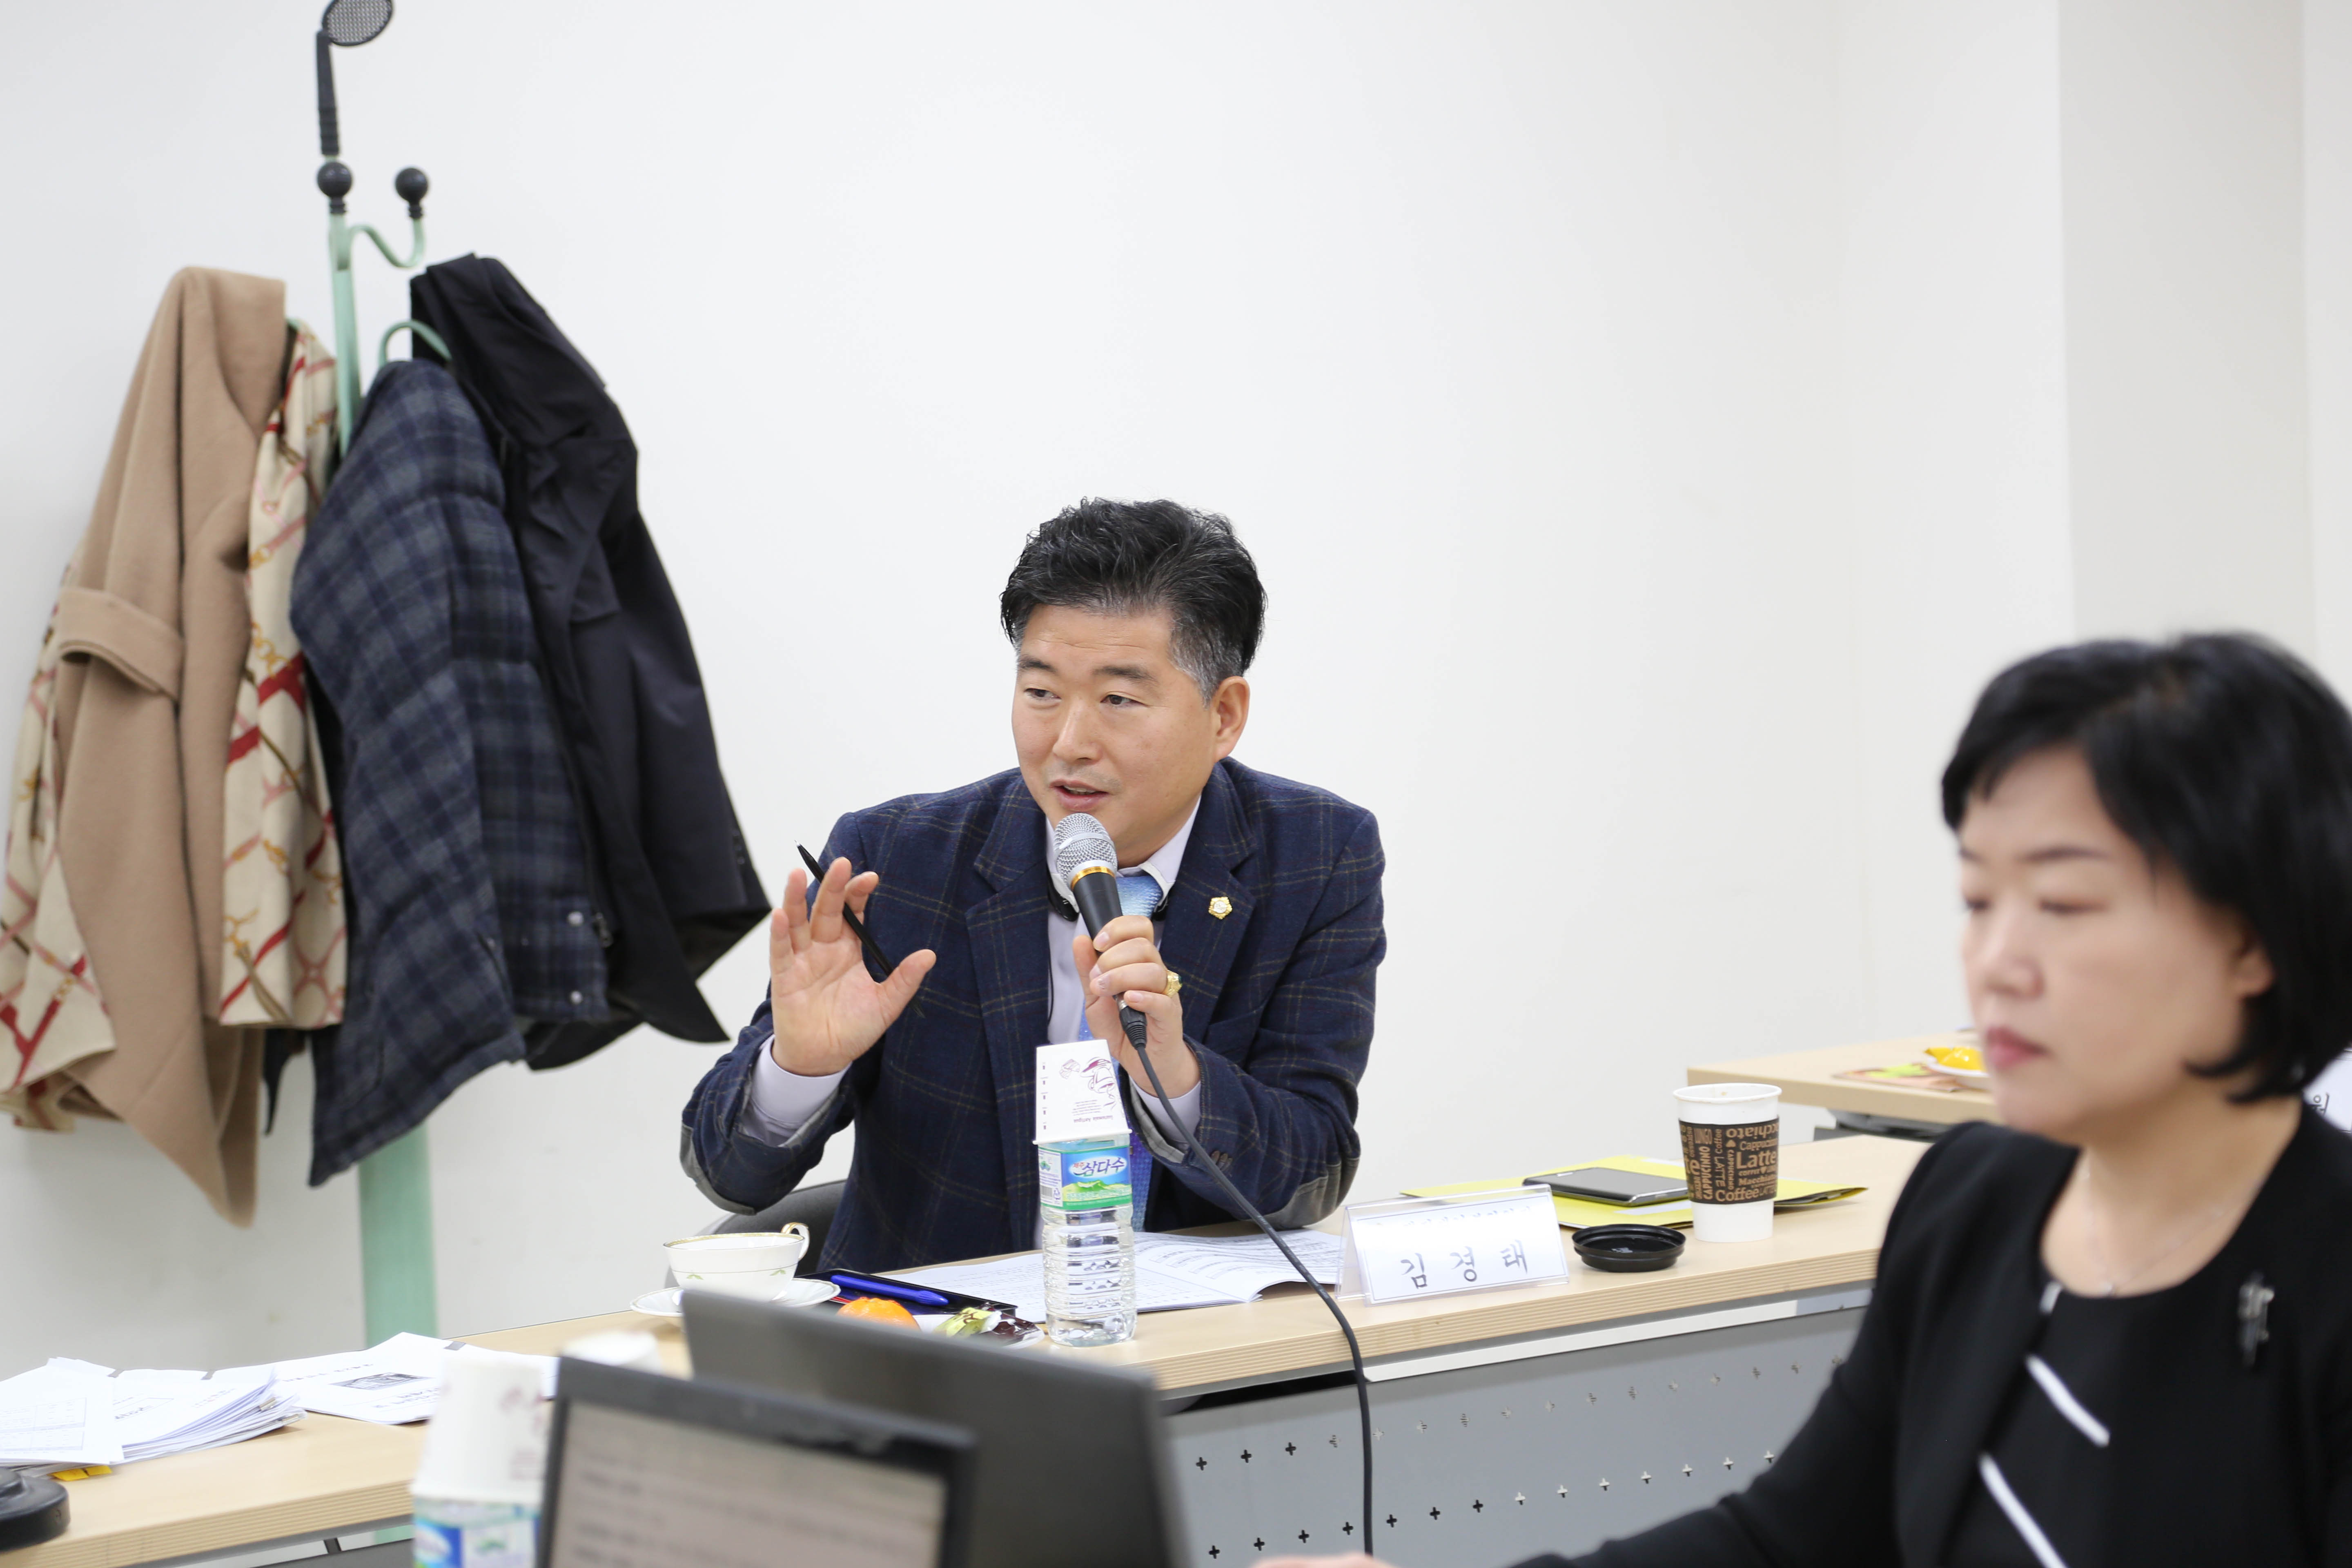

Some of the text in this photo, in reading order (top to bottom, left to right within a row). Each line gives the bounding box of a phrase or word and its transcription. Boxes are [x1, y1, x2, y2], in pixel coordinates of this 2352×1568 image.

[1082, 1157, 1125, 1177] 삼다수
[1736, 1150, 1777, 1169] Latte
[1714, 1156, 1726, 1187] LATTE
[1715, 1187, 1760, 1202] Coffee
